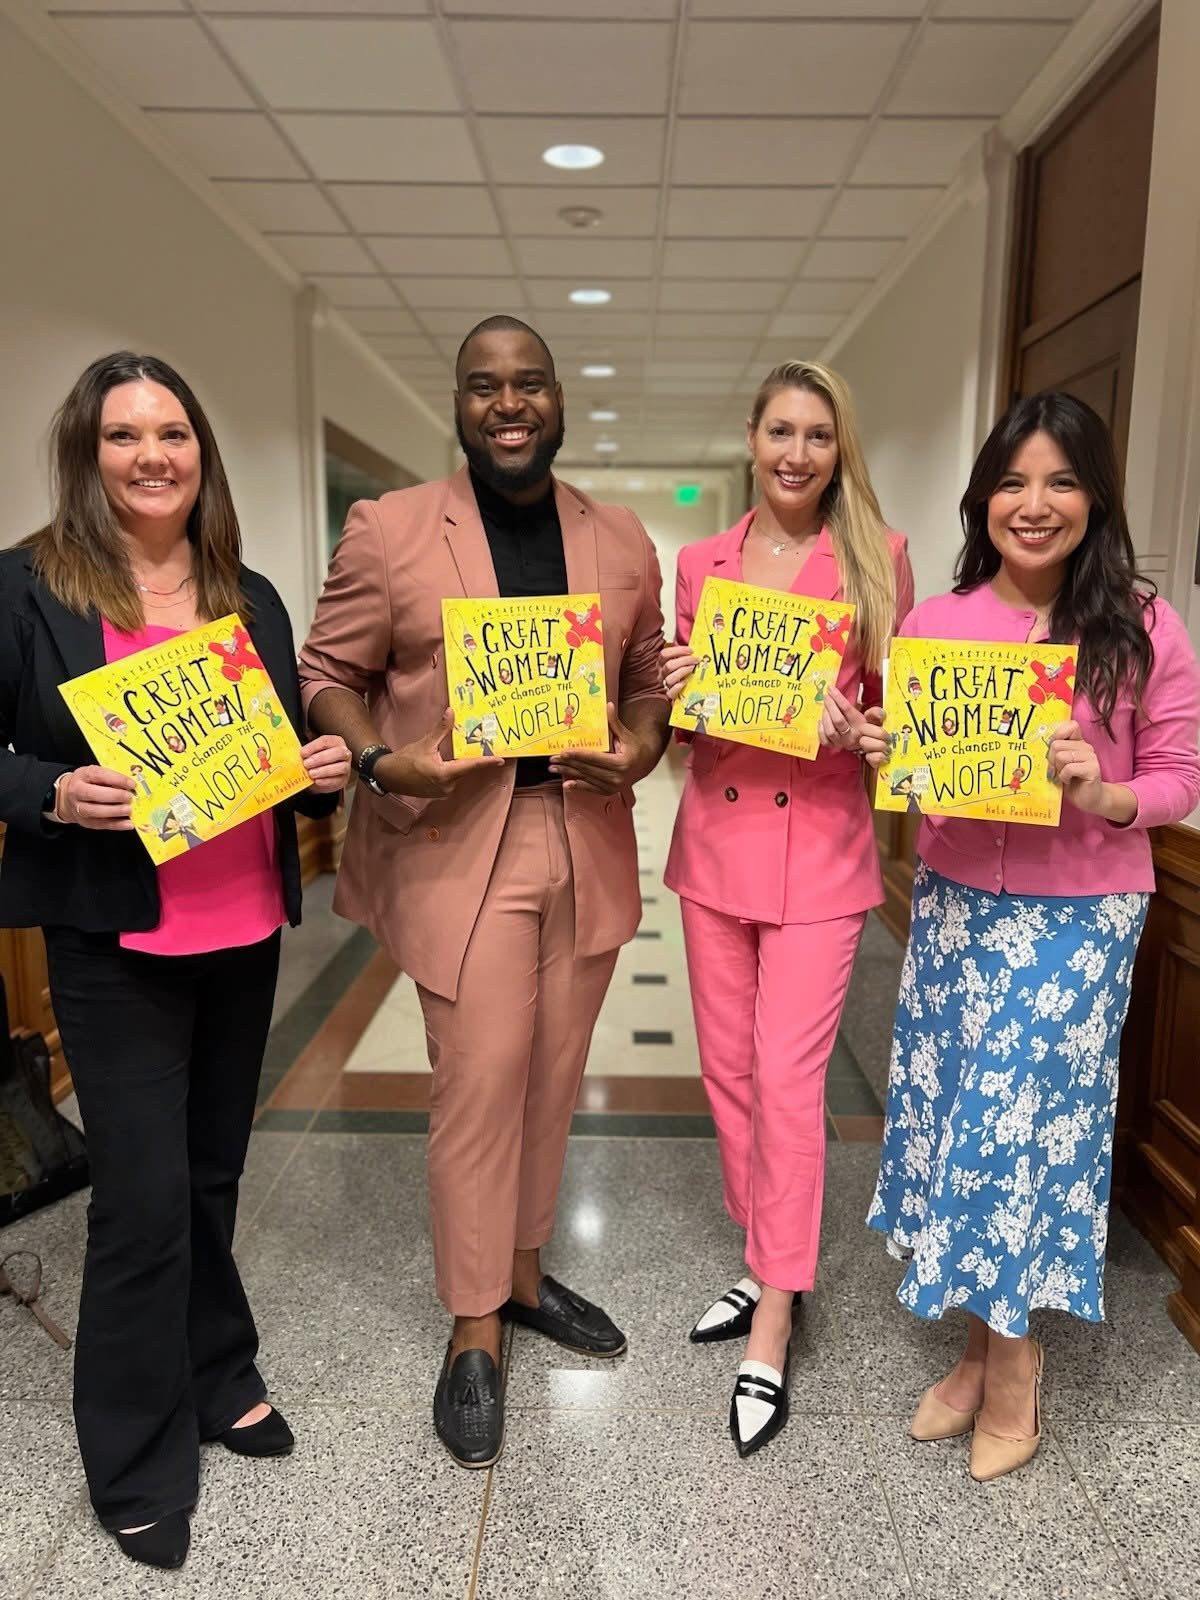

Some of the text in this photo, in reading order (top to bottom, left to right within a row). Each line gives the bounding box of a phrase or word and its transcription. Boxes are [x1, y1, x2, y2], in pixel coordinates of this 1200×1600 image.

[482, 618, 559, 653] GREAT
[732, 607, 810, 646] GREAT
[464, 648, 575, 696] WOMEN
[709, 634, 814, 681] WOMEN
[922, 650, 1029, 666] FANTASTICALLY
[123, 657, 212, 725] GREAT
[557, 681, 573, 691] THE
[787, 681, 802, 690] THE
[930, 665, 1024, 701] GREAT
[494, 693, 580, 745] WORLD
[719, 690, 803, 726] WORLD
[905, 700, 1036, 747] WOMEN
[117, 684, 246, 778] WOMEN
[237, 721, 255, 736] THE
[1008, 742, 1028, 750] THE
[180, 732, 272, 821] WORLD
[929, 754, 1032, 802] WORLD
